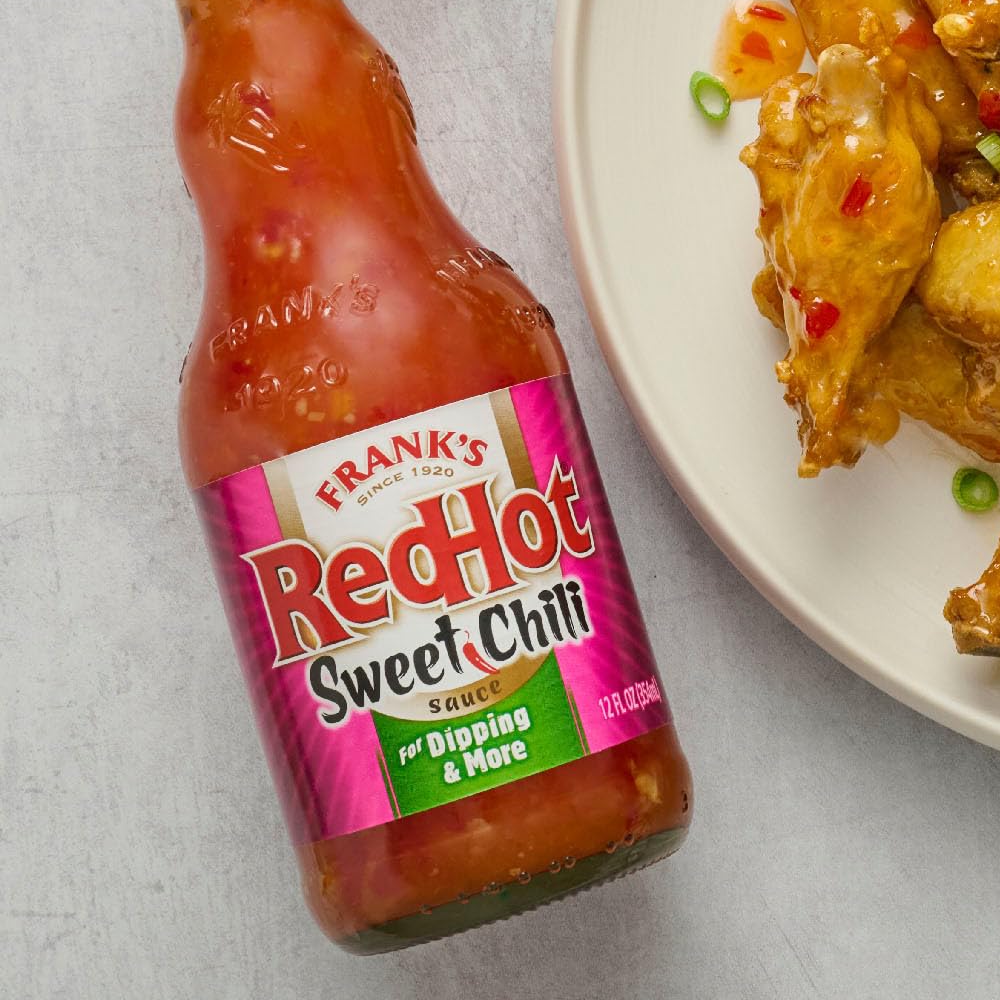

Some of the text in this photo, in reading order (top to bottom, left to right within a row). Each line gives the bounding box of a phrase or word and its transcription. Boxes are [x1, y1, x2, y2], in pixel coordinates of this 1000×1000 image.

[315, 430, 488, 512] FRANK'S
[357, 465, 454, 506] SINCE 1920
[241, 455, 595, 668] RedHot
[310, 580, 591, 724] Sweet Chili
[428, 679, 502, 713] sauce
[598, 695, 614, 720] 12
[610, 691, 627, 716] FL
[623, 686, 639, 711] OZ
[399, 707, 531, 766] For Dipping
[443, 740, 528, 784] & More
